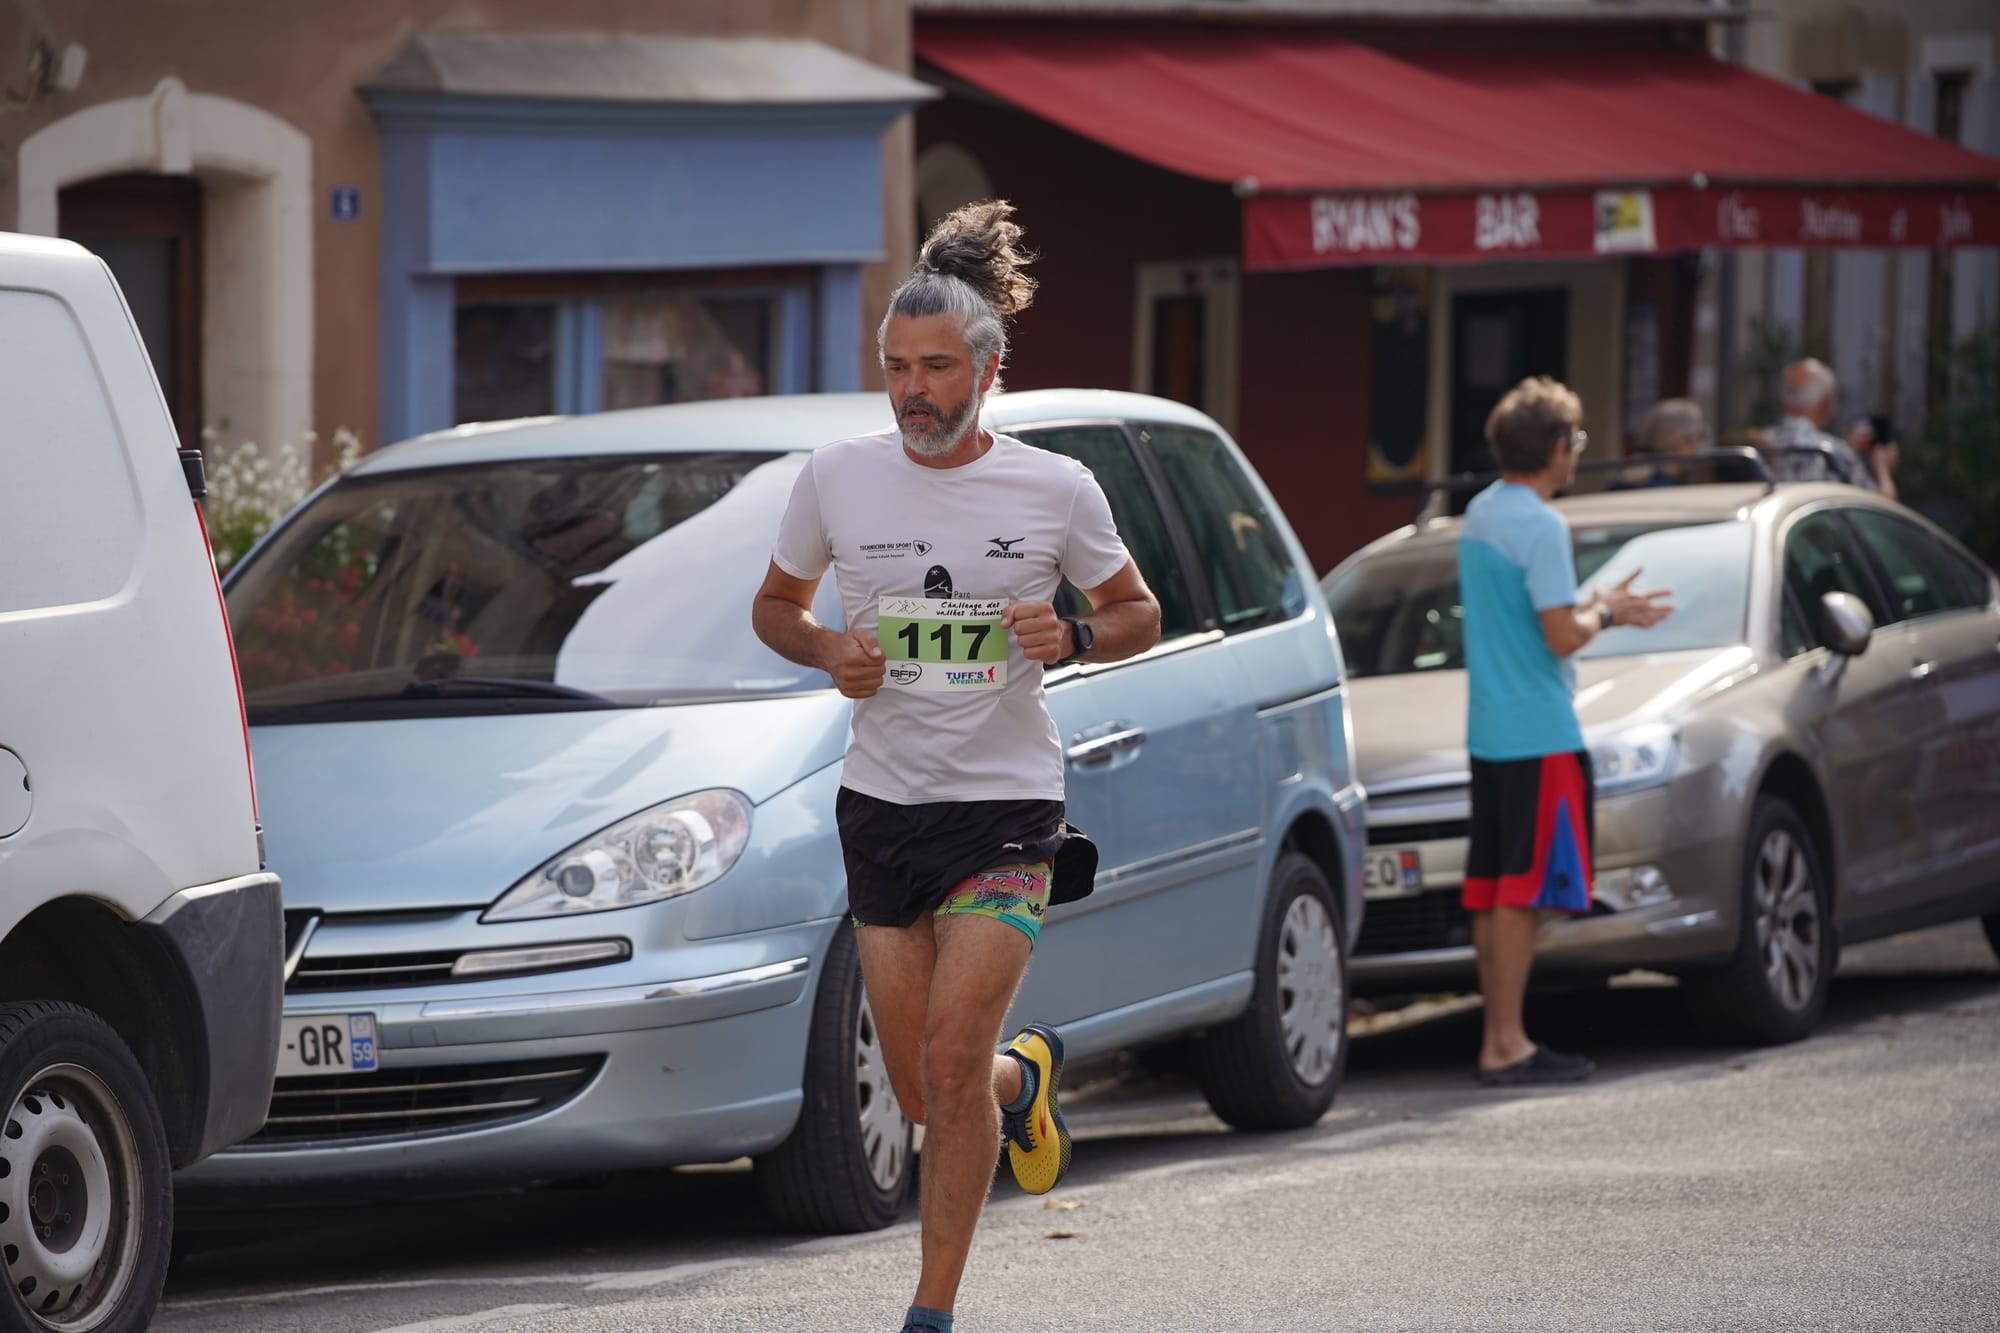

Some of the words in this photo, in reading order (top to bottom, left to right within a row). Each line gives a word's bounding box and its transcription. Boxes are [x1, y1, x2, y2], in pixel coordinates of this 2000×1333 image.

[1312, 194, 1421, 253] RYAN'S
[1474, 193, 1541, 249] BAR
[860, 543, 886, 551] TECHNICIEN
[954, 590, 971, 599] Parc
[941, 601, 982, 610] Challenge
[936, 608, 964, 617] vallées
[898, 622, 991, 660] 117
[890, 669, 918, 678] BFP
[946, 671, 984, 680] TUFF'S
[352, 1042, 373, 1062] 59
